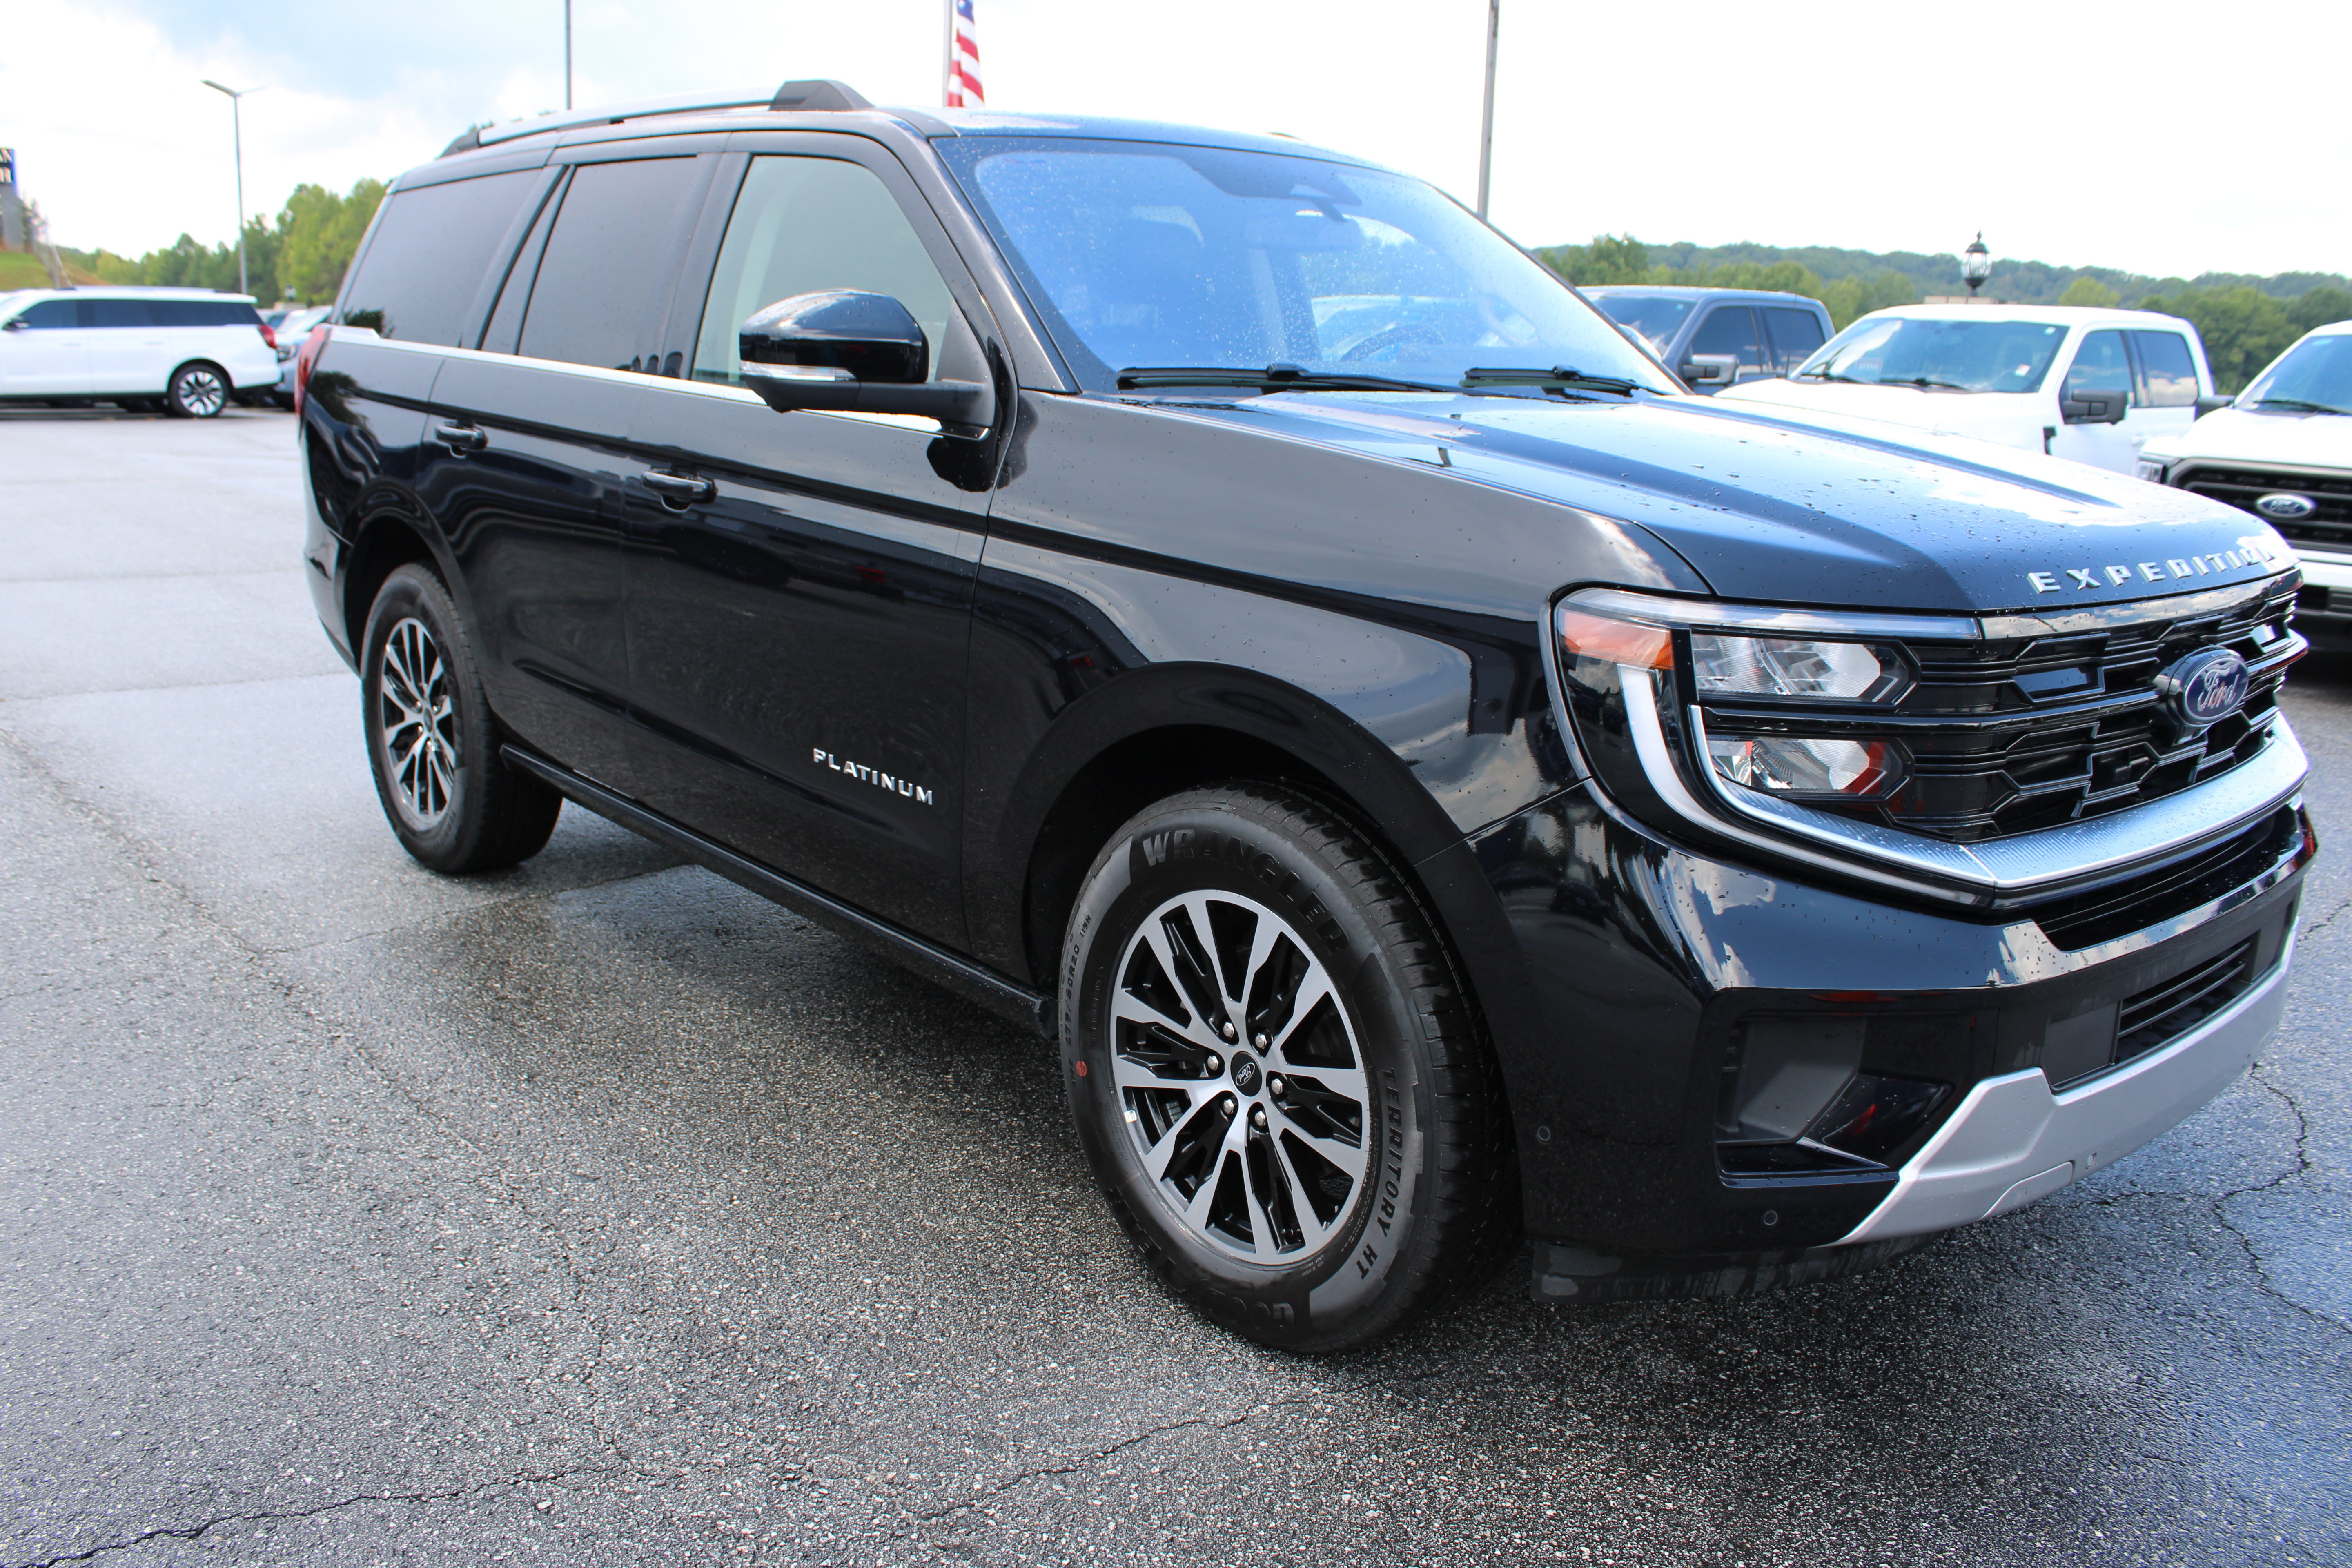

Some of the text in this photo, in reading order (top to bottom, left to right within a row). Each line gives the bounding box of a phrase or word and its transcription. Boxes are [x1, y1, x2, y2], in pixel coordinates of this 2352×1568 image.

[2197, 662, 2240, 710] Ford
[813, 748, 933, 806] PLATINUM
[1143, 829, 1349, 956] WRANGLER
[1377, 1068, 1403, 1238] TERRITORY
[1359, 1243, 1378, 1280] HT
